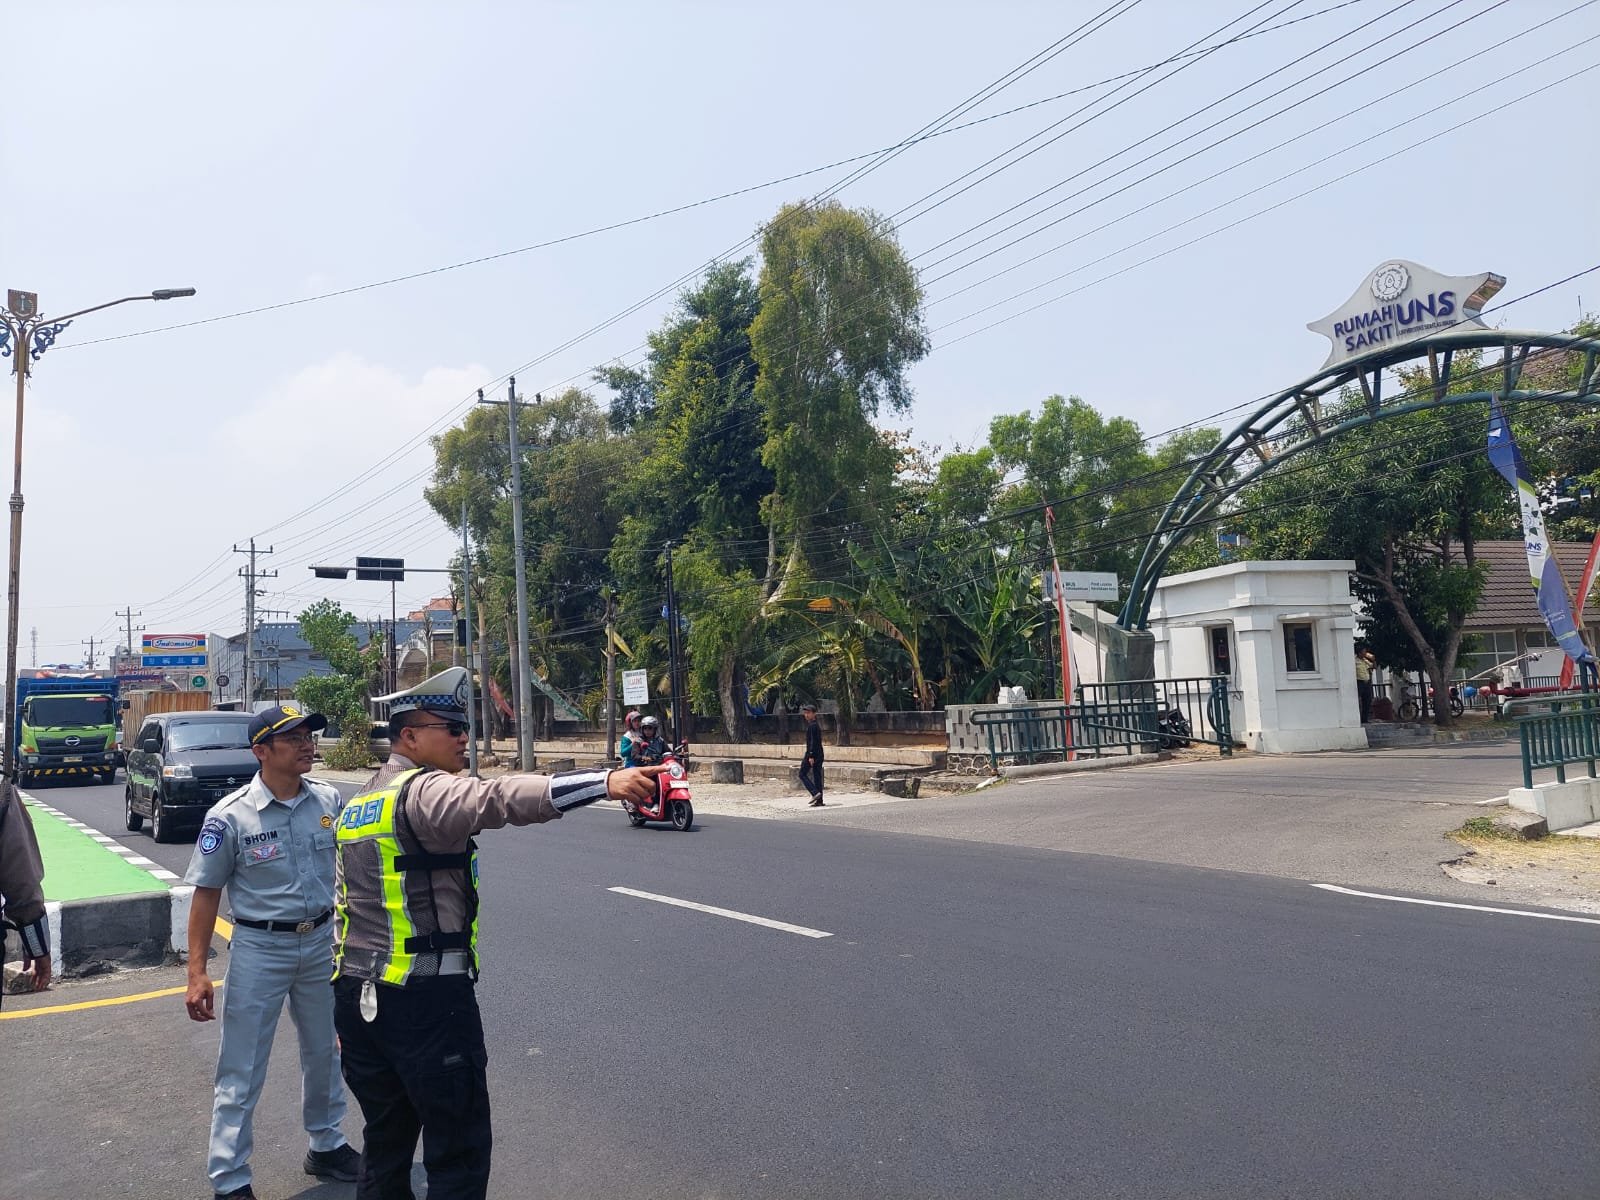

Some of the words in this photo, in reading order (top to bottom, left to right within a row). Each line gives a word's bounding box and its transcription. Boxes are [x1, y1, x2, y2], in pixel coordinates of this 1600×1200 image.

[1334, 306, 1393, 338] RUMAH
[1397, 291, 1455, 324] UNS
[1346, 323, 1393, 351] SAKIT
[156, 639, 194, 647] Indomaret
[341, 797, 385, 829] POLISI
[245, 830, 278, 844] SHOIM
